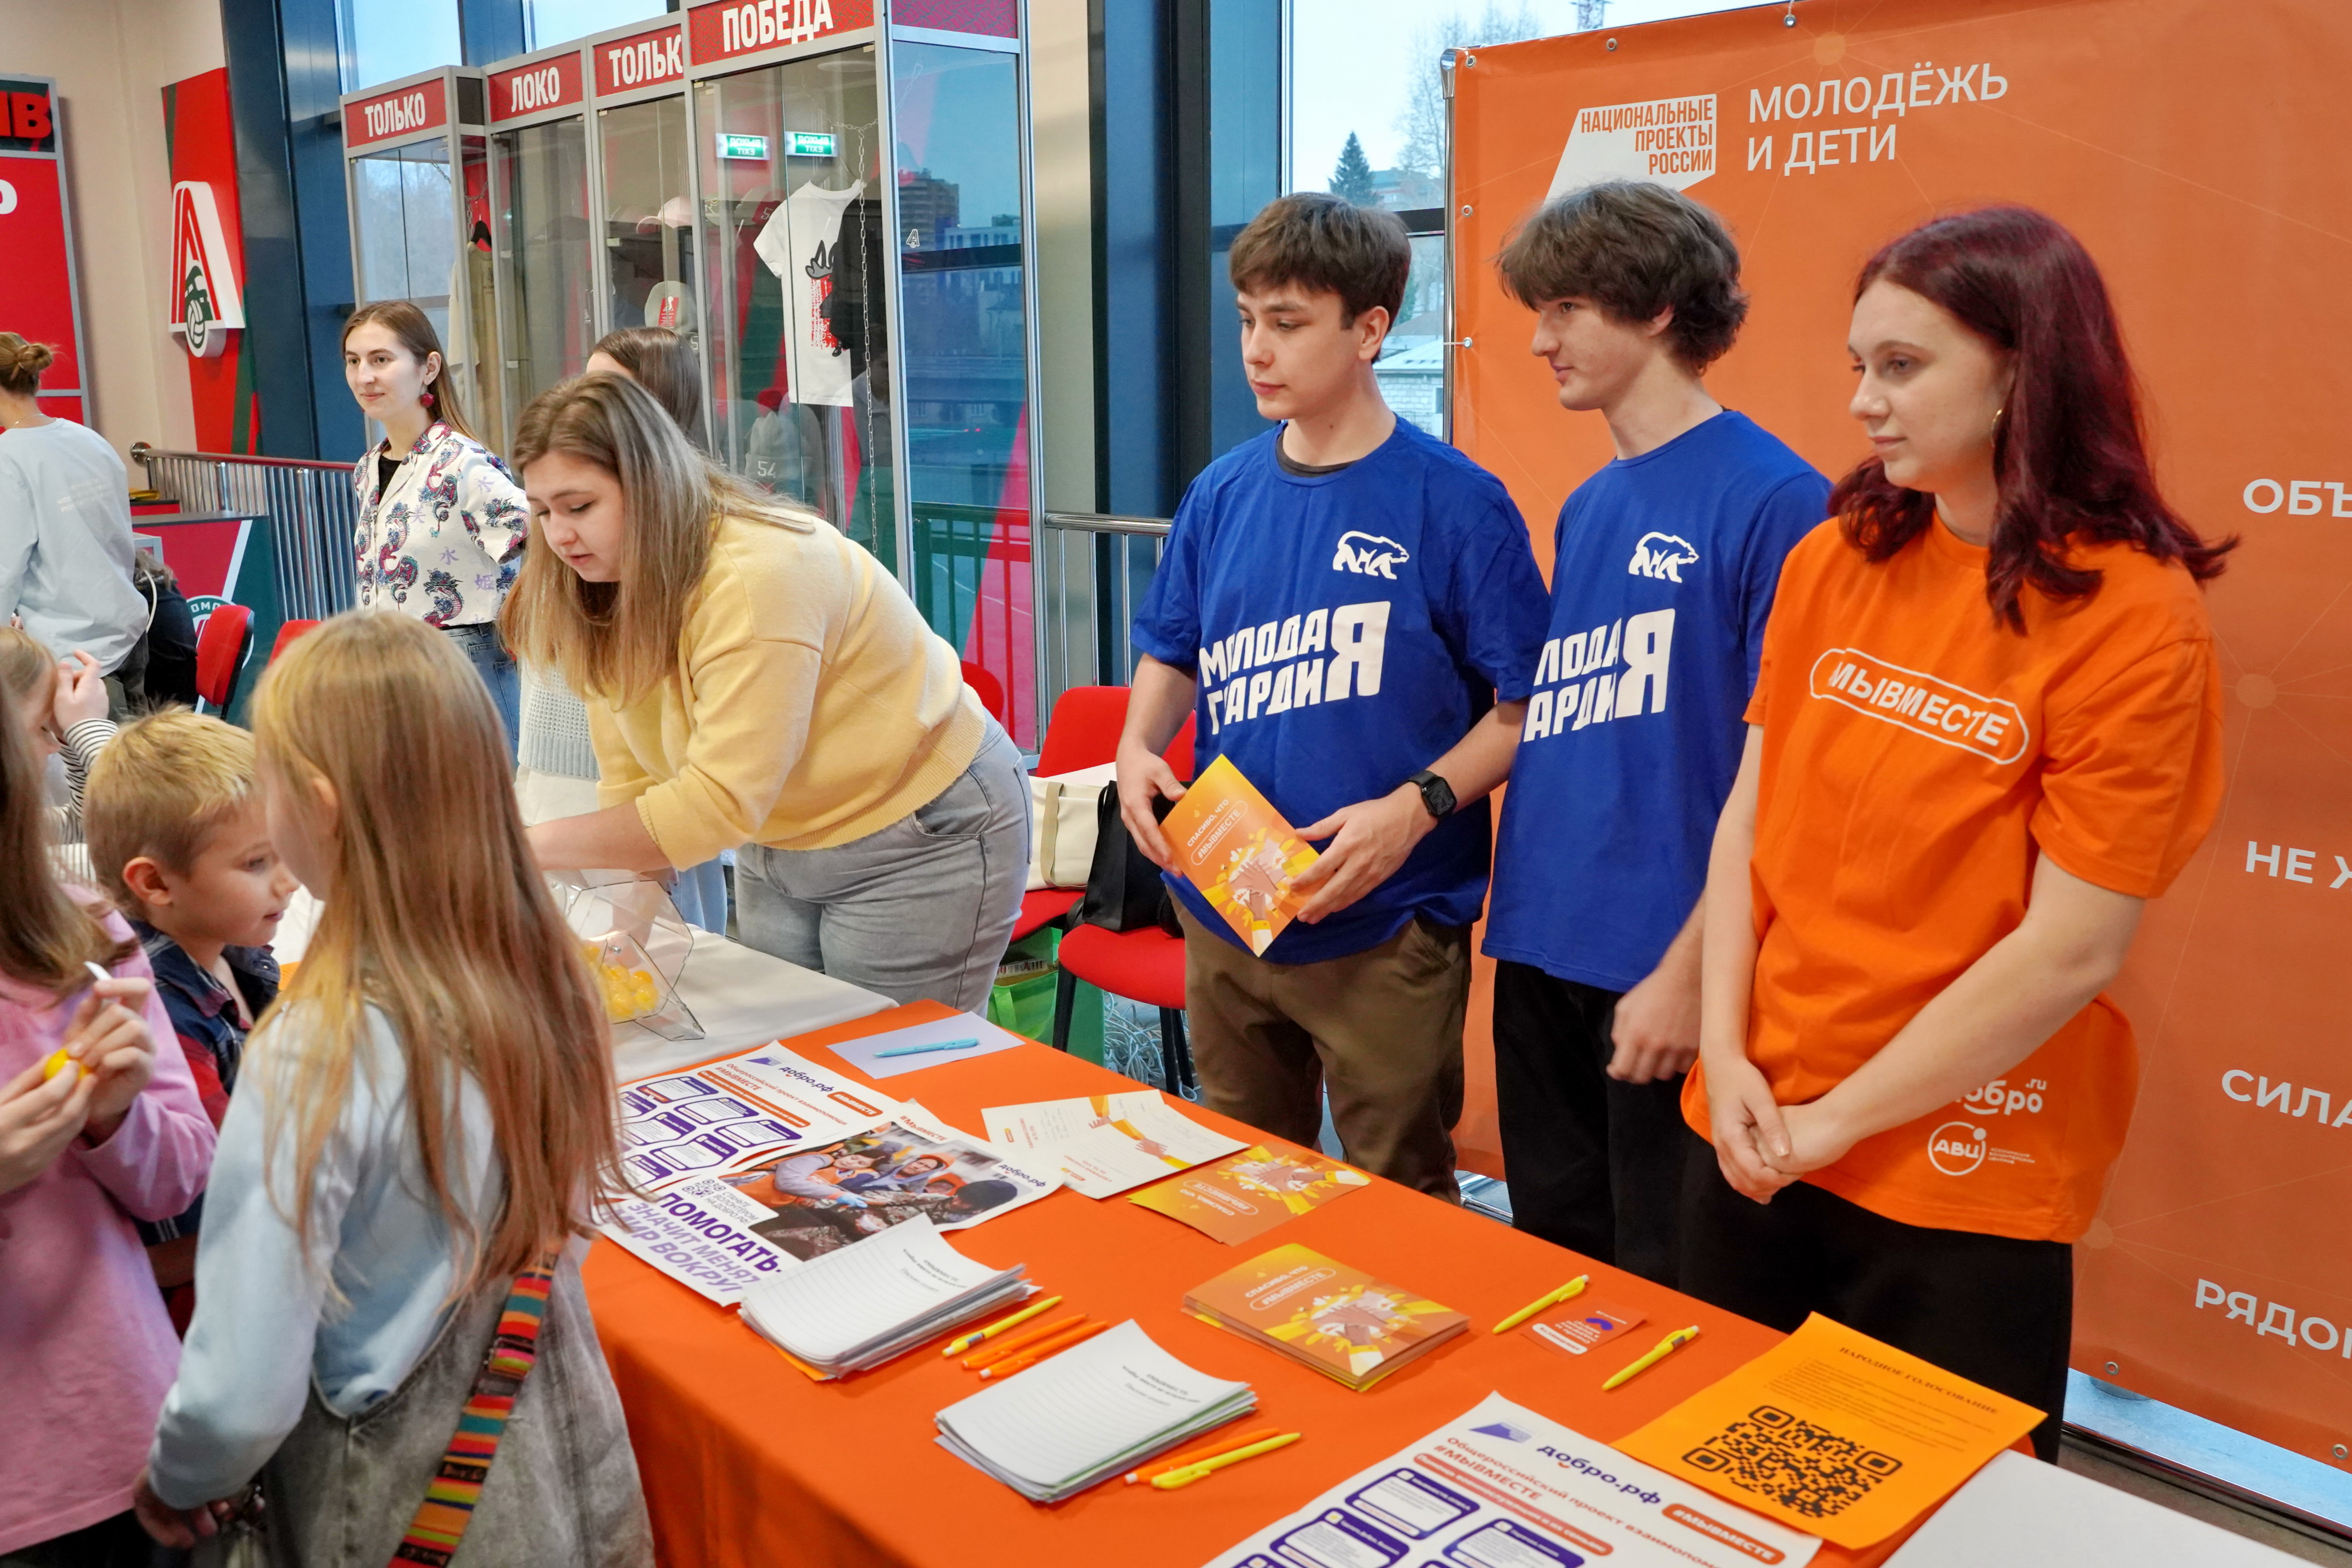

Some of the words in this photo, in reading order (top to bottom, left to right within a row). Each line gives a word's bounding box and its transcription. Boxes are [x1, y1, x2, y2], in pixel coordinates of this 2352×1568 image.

[723, 0, 834, 52] ПОБЕДА
[511, 67, 560, 112] ЛОКО
[1749, 61, 2008, 123] МОЛОДЁЖЬ
[365, 92, 425, 137] ТОЛЬКО
[1581, 98, 1713, 133] НАЦИОНАЛЬНЫЕ
[1635, 124, 1712, 152] ПРОЕКТЫ
[1748, 136, 1772, 171] И
[1784, 124, 1896, 176] ДЕТИ
[1649, 149, 1712, 175] РОССИИ
[1187, 814, 1217, 847] СПАСИБО,
[1214, 799, 1229, 813] ЧТО
[1197, 809, 1240, 859] #МЫВМЕСТЕ
[2246, 841, 2315, 883] НЕ
[714, 1067, 762, 1091] #МЫВМЕСТЕ
[779, 1066, 835, 1092] добро.рф
[1933, 1139, 1979, 1159] АВЦ
[628, 1203, 701, 1245] ЗНАЧИТ
[1839, 1347, 1903, 1376] НАРОДНОЕ
[1905, 1374, 1999, 1414] ГОЛОСОВАНИЕ
[1434, 1445, 1543, 1500] #МЫВМЕСТЕ
[1447, 1437, 1569, 1498] Общероссийский
[1537, 1445, 1663, 1505] добро.рф
[1672, 1508, 1776, 1561] #МЫВМЕСТЕ
